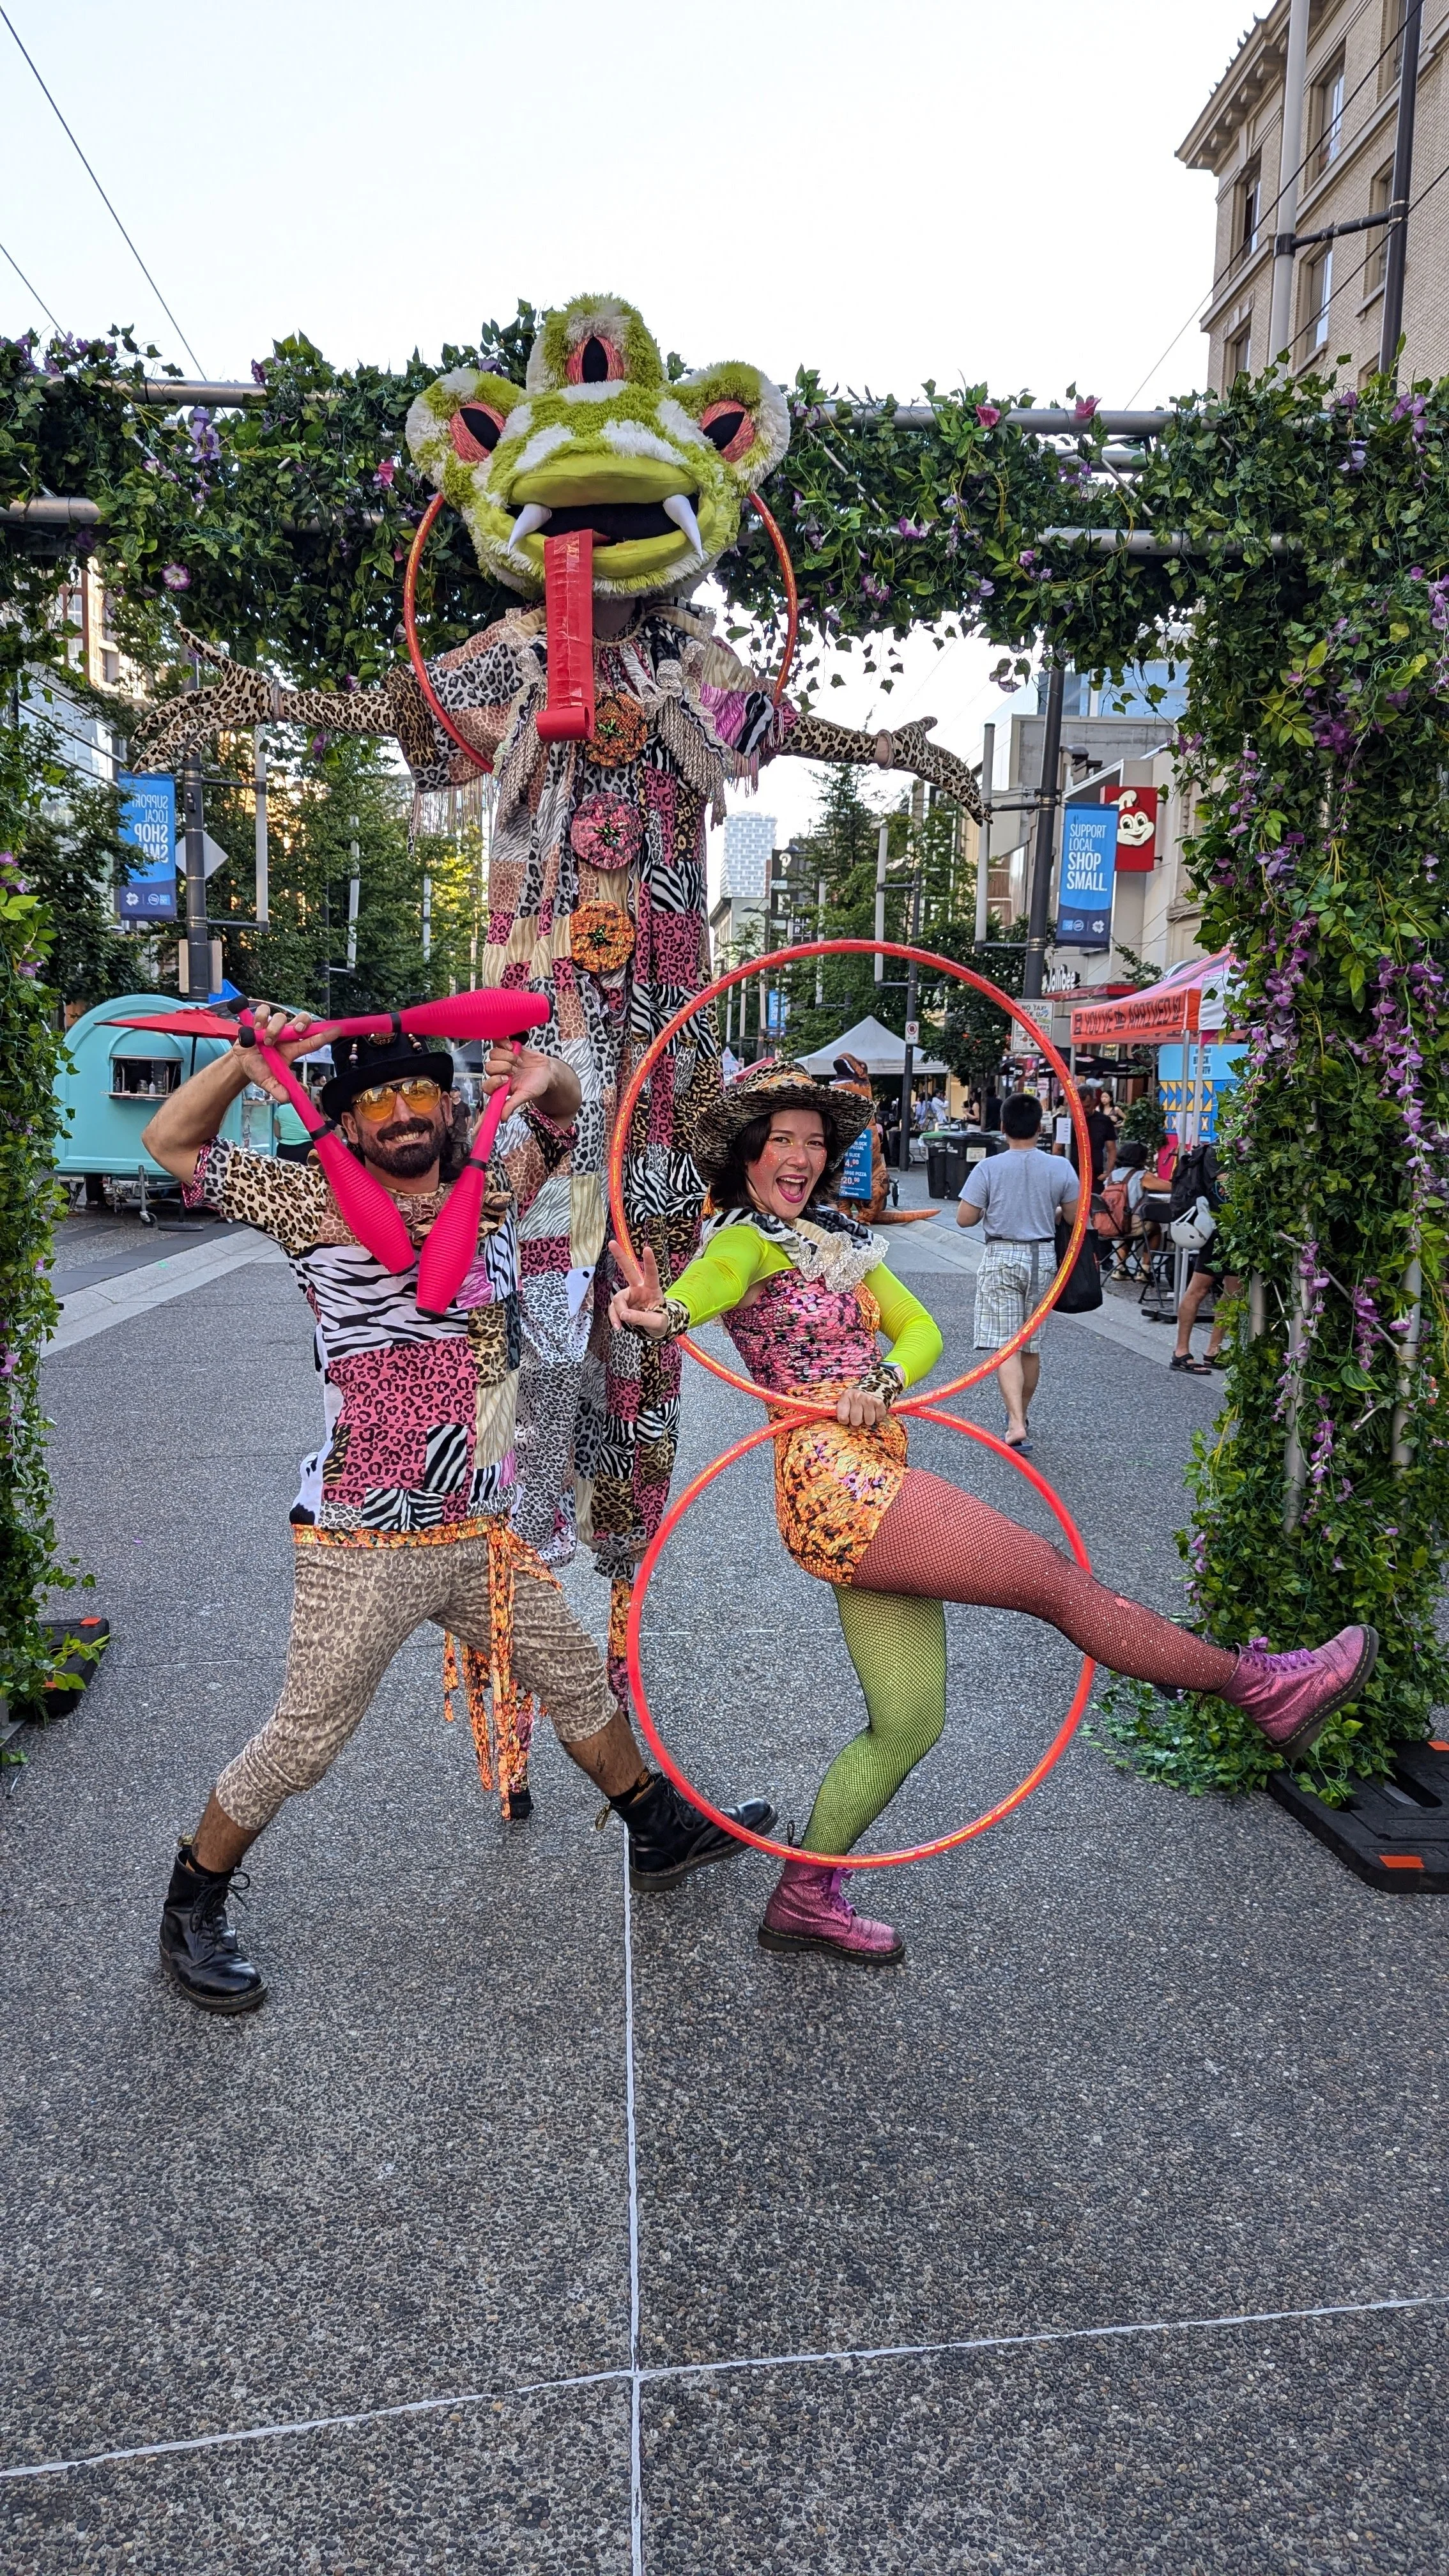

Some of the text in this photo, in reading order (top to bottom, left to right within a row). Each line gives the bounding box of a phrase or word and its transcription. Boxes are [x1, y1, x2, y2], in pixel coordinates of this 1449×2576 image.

[1070, 824, 1107, 838] SUPPORT
[1069, 838, 1095, 851] LOCAL
[1068, 852, 1101, 871] SHOP
[1047, 964, 1075, 993] Jollibee
[1128, 997, 1170, 1030] ARRIVED
